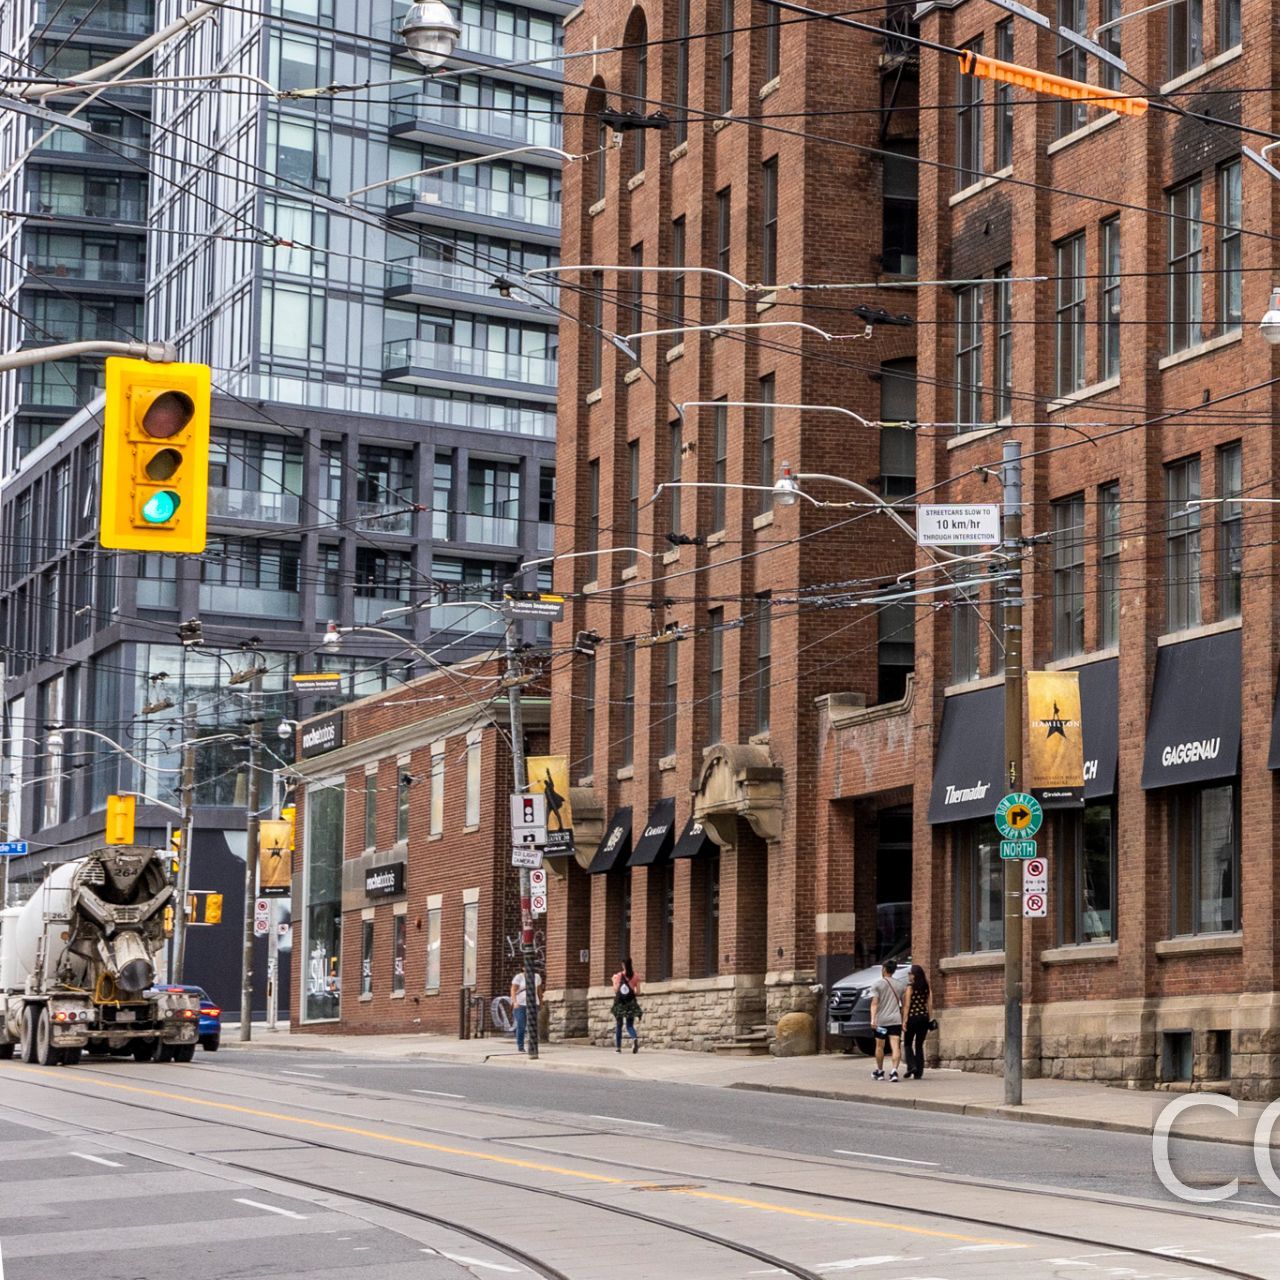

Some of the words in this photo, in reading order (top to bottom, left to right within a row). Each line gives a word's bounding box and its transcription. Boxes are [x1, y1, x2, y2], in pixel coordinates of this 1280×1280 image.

[937, 519, 949, 530] 10
[951, 519, 981, 530] km/hr
[1032, 720, 1080, 728] HAMILTON
[1162, 737, 1221, 767] GAGGENAU
[997, 799, 1010, 816] DON
[1013, 793, 1041, 815] VALLEY
[1000, 824, 1036, 839] PARKWAY
[1003, 842, 1034, 856] NORTH
[115, 869, 138, 878] 264
